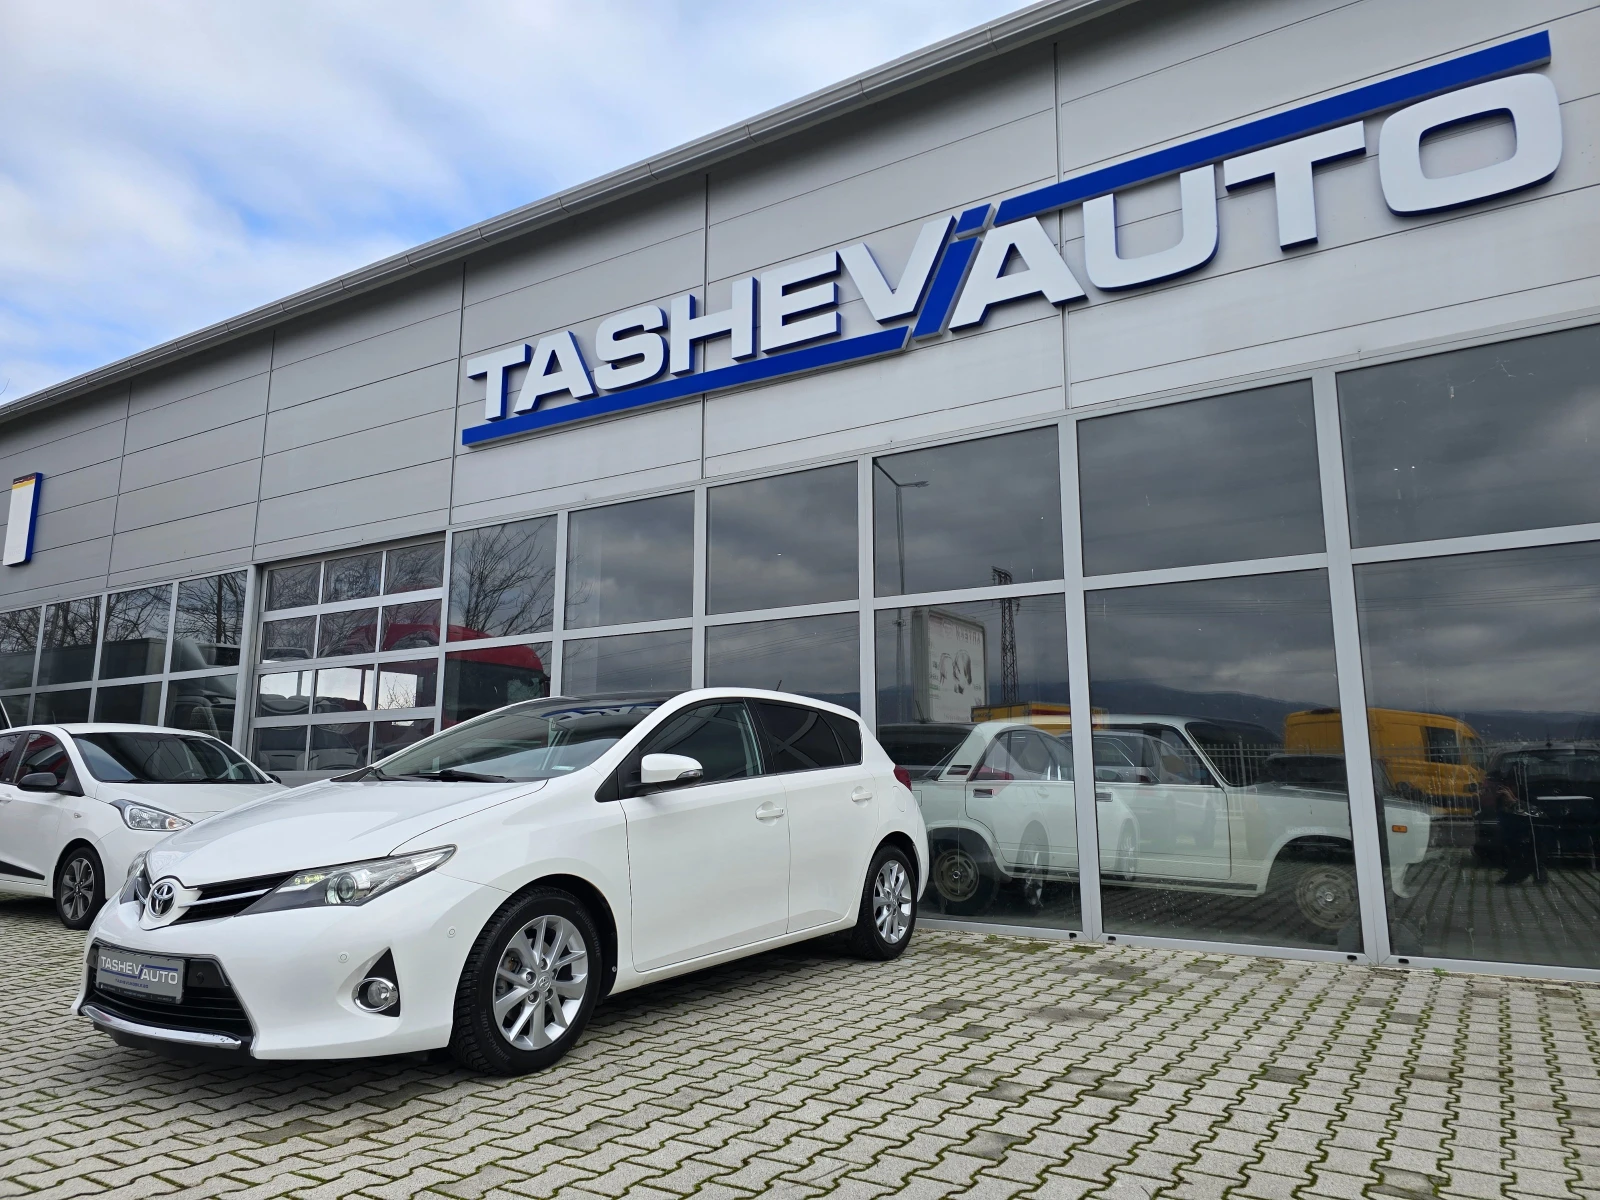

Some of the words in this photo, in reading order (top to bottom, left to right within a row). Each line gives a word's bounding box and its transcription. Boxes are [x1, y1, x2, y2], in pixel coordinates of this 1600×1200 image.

[466, 215, 957, 422] TASHEV
[949, 73, 1563, 333] AUTO
[101, 956, 142, 975] TASHEV
[140, 969, 178, 985] AUTO
